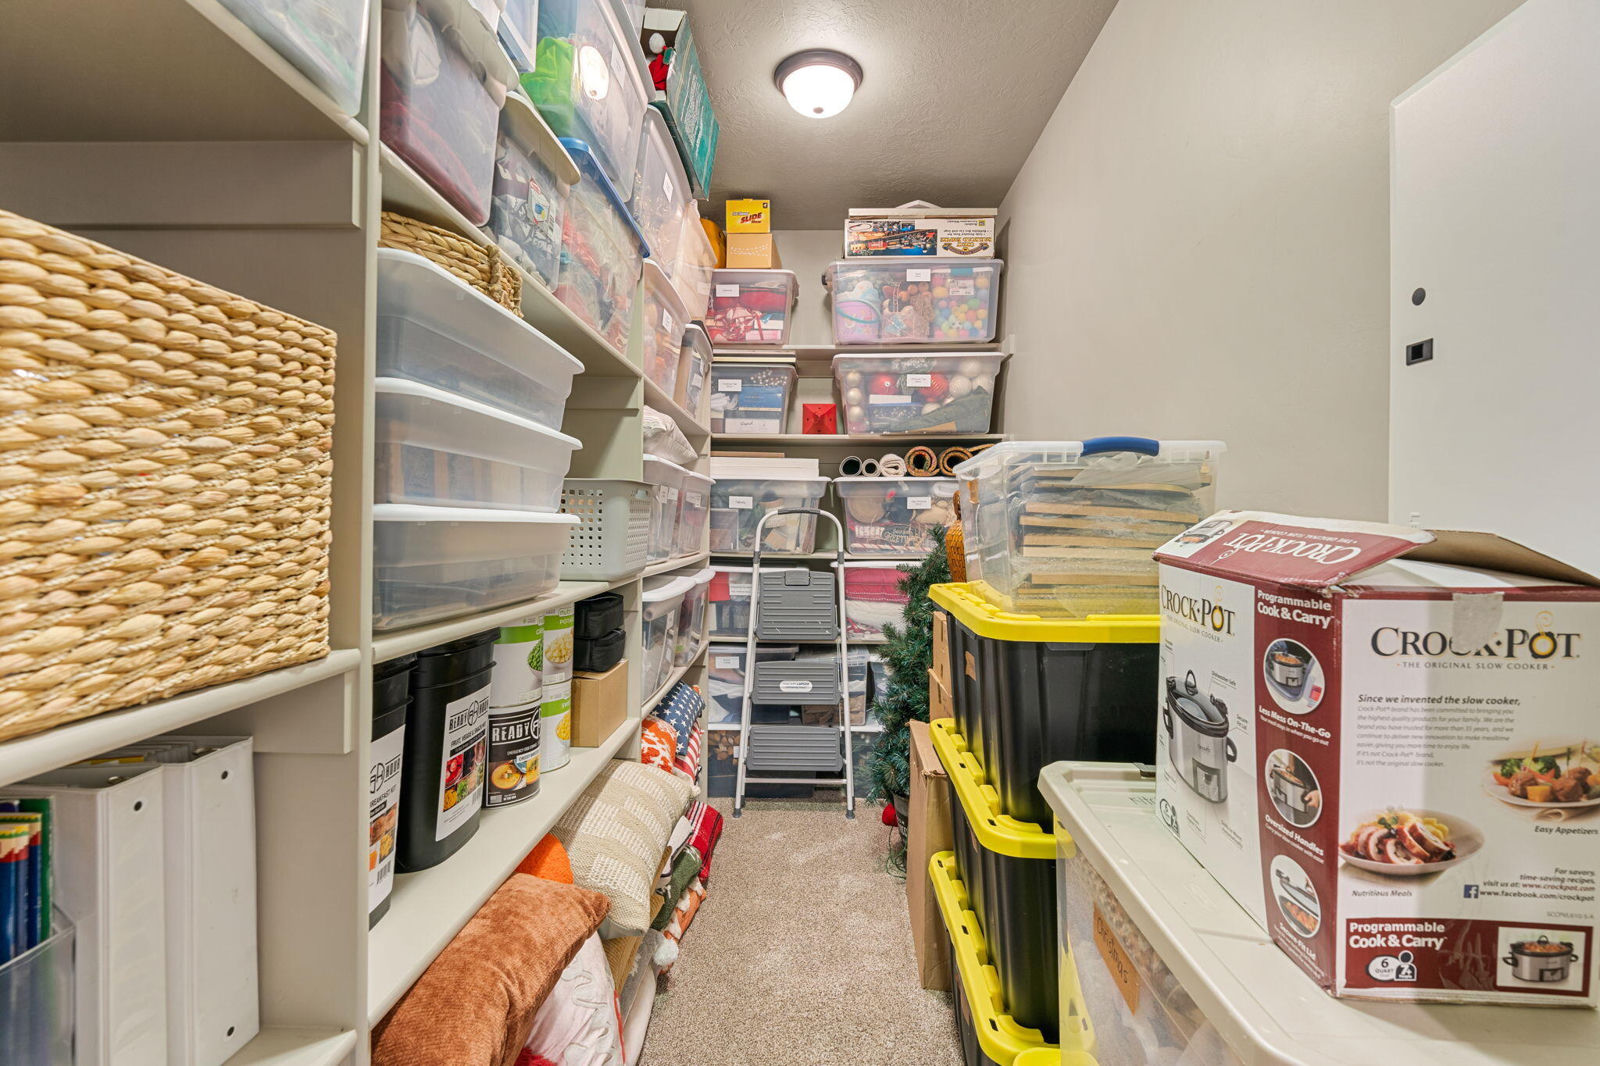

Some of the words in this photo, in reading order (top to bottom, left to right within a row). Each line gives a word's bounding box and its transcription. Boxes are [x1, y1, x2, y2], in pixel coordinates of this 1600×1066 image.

[1257, 590, 1332, 611] Programmable
[1257, 603, 1280, 619] Cook
[1280, 608, 1292, 621] &
[1292, 608, 1333, 630] Carry
[1358, 694, 1384, 702] Since
[1400, 695, 1444, 704] invented
[1444, 696, 1460, 704] the
[1462, 696, 1484, 705] slow
[1486, 696, 1520, 706] cooker,
[492, 722, 530, 742] READY
[1287, 718, 1332, 738] On-The-Go
[1265, 814, 1295, 838] Oversized
[1295, 833, 1324, 856] Handles
[1534, 826, 1554, 834] Easy
[1554, 826, 1599, 836] Appetizers
[1522, 882, 1596, 892] www.crockpot.com
[1480, 890, 1595, 902] www.facebook.com/crockpot
[1350, 922, 1446, 934] Programmable
[1349, 934, 1386, 948] Cook
[1388, 934, 1400, 947] &
[1402, 934, 1446, 951] Carry
[1380, 958, 1389, 968] 6
